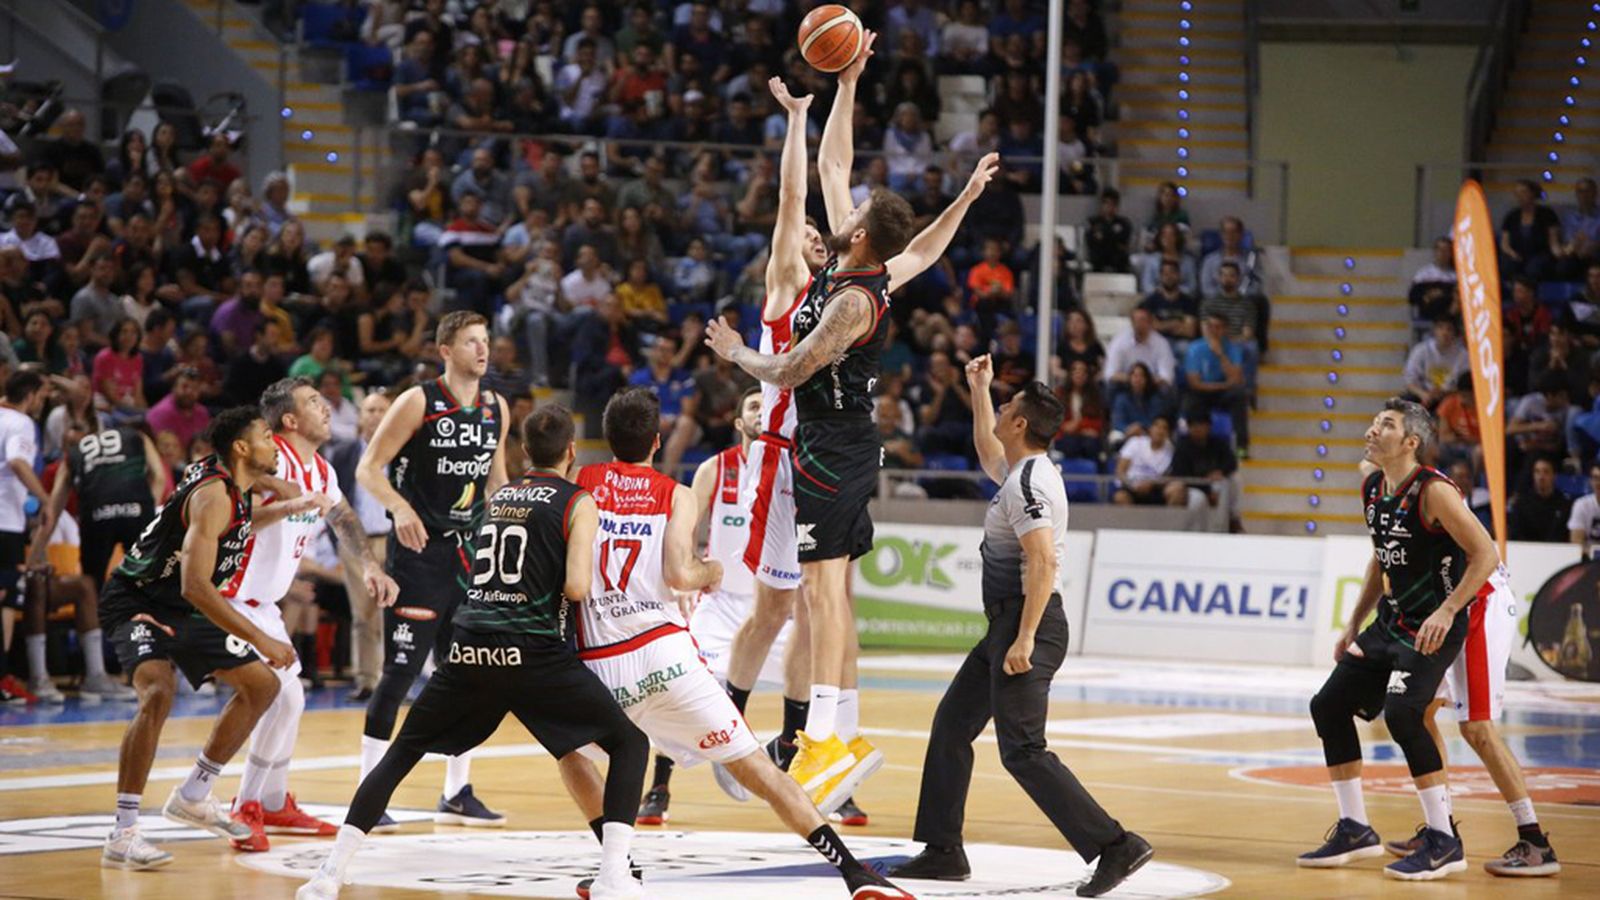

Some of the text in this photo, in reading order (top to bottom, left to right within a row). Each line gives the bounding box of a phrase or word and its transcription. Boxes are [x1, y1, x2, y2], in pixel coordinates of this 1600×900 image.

[79, 430, 122, 461] 99
[459, 423, 481, 446] 24
[473, 523, 528, 585] 30
[599, 539, 643, 593] 17
[859, 536, 958, 589] OK
[449, 641, 522, 666] Bankia
[635, 662, 688, 694] RURAL
